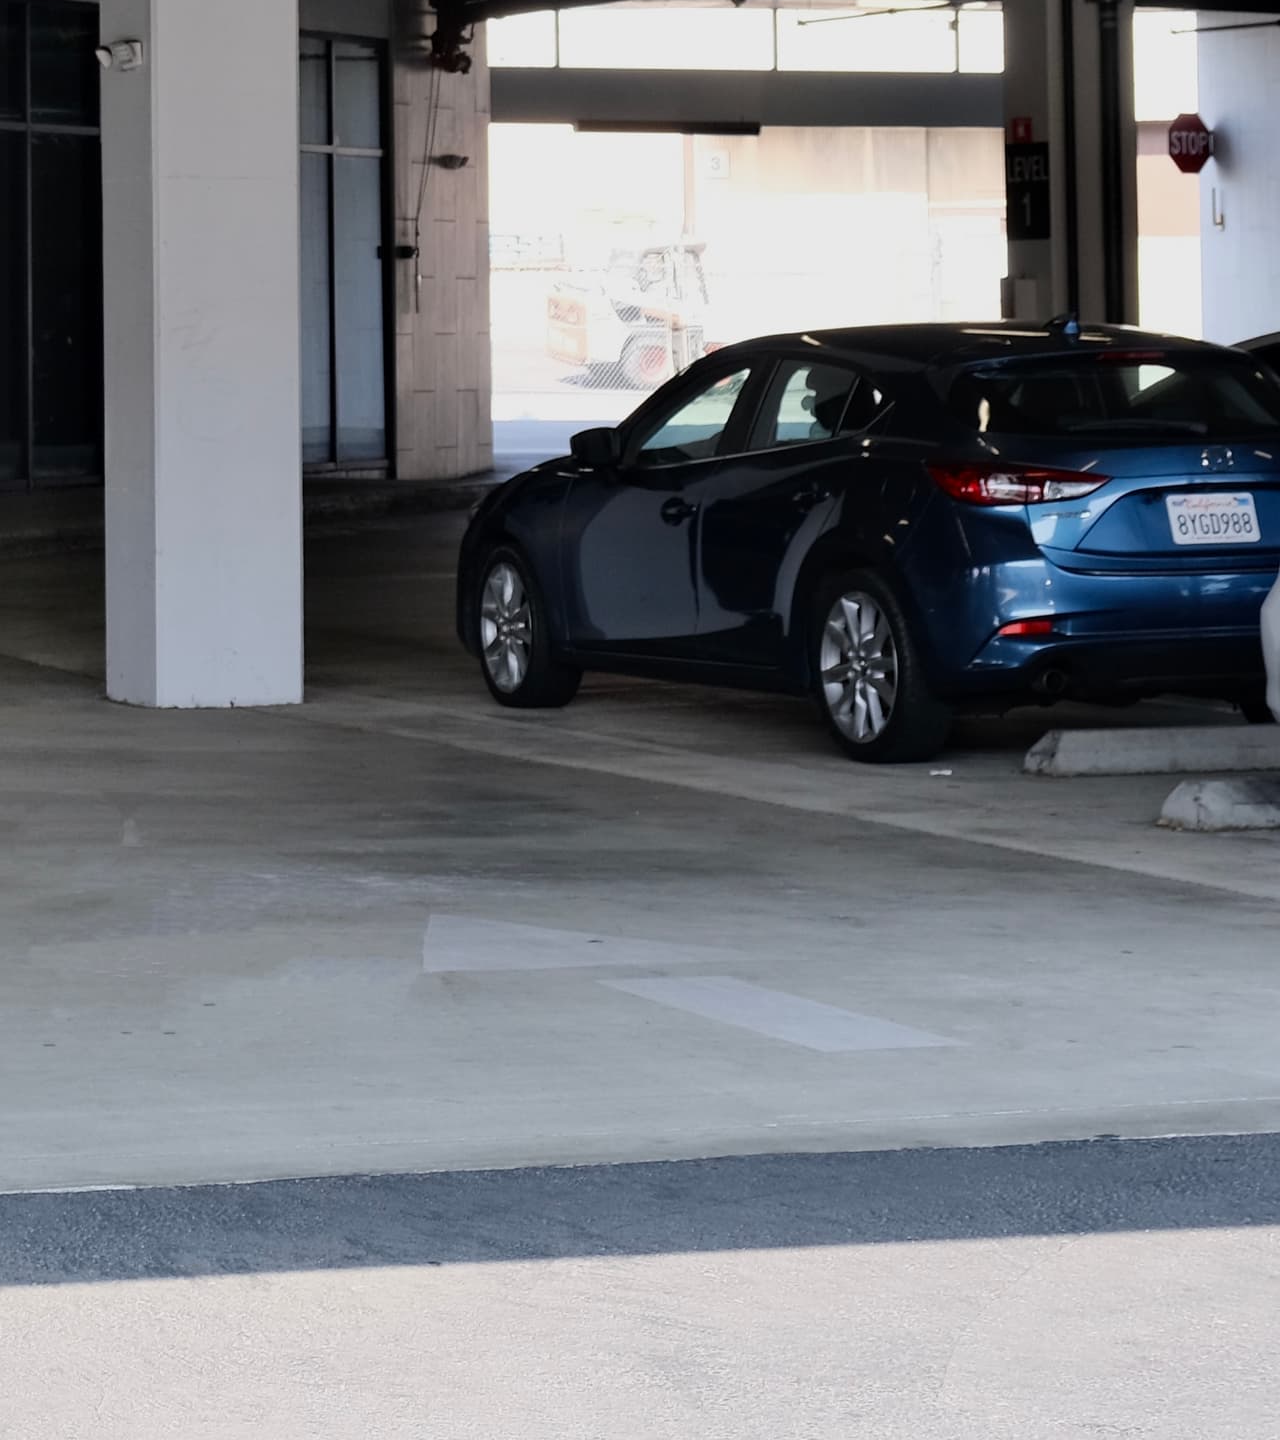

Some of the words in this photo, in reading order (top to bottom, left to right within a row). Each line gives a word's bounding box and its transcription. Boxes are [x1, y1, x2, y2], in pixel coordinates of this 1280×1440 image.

[1170, 131, 1208, 155] STOP
[1007, 155, 1049, 182] LEVEL
[1023, 192, 1031, 227] 1
[1177, 512, 1253, 536] 8YGD988
